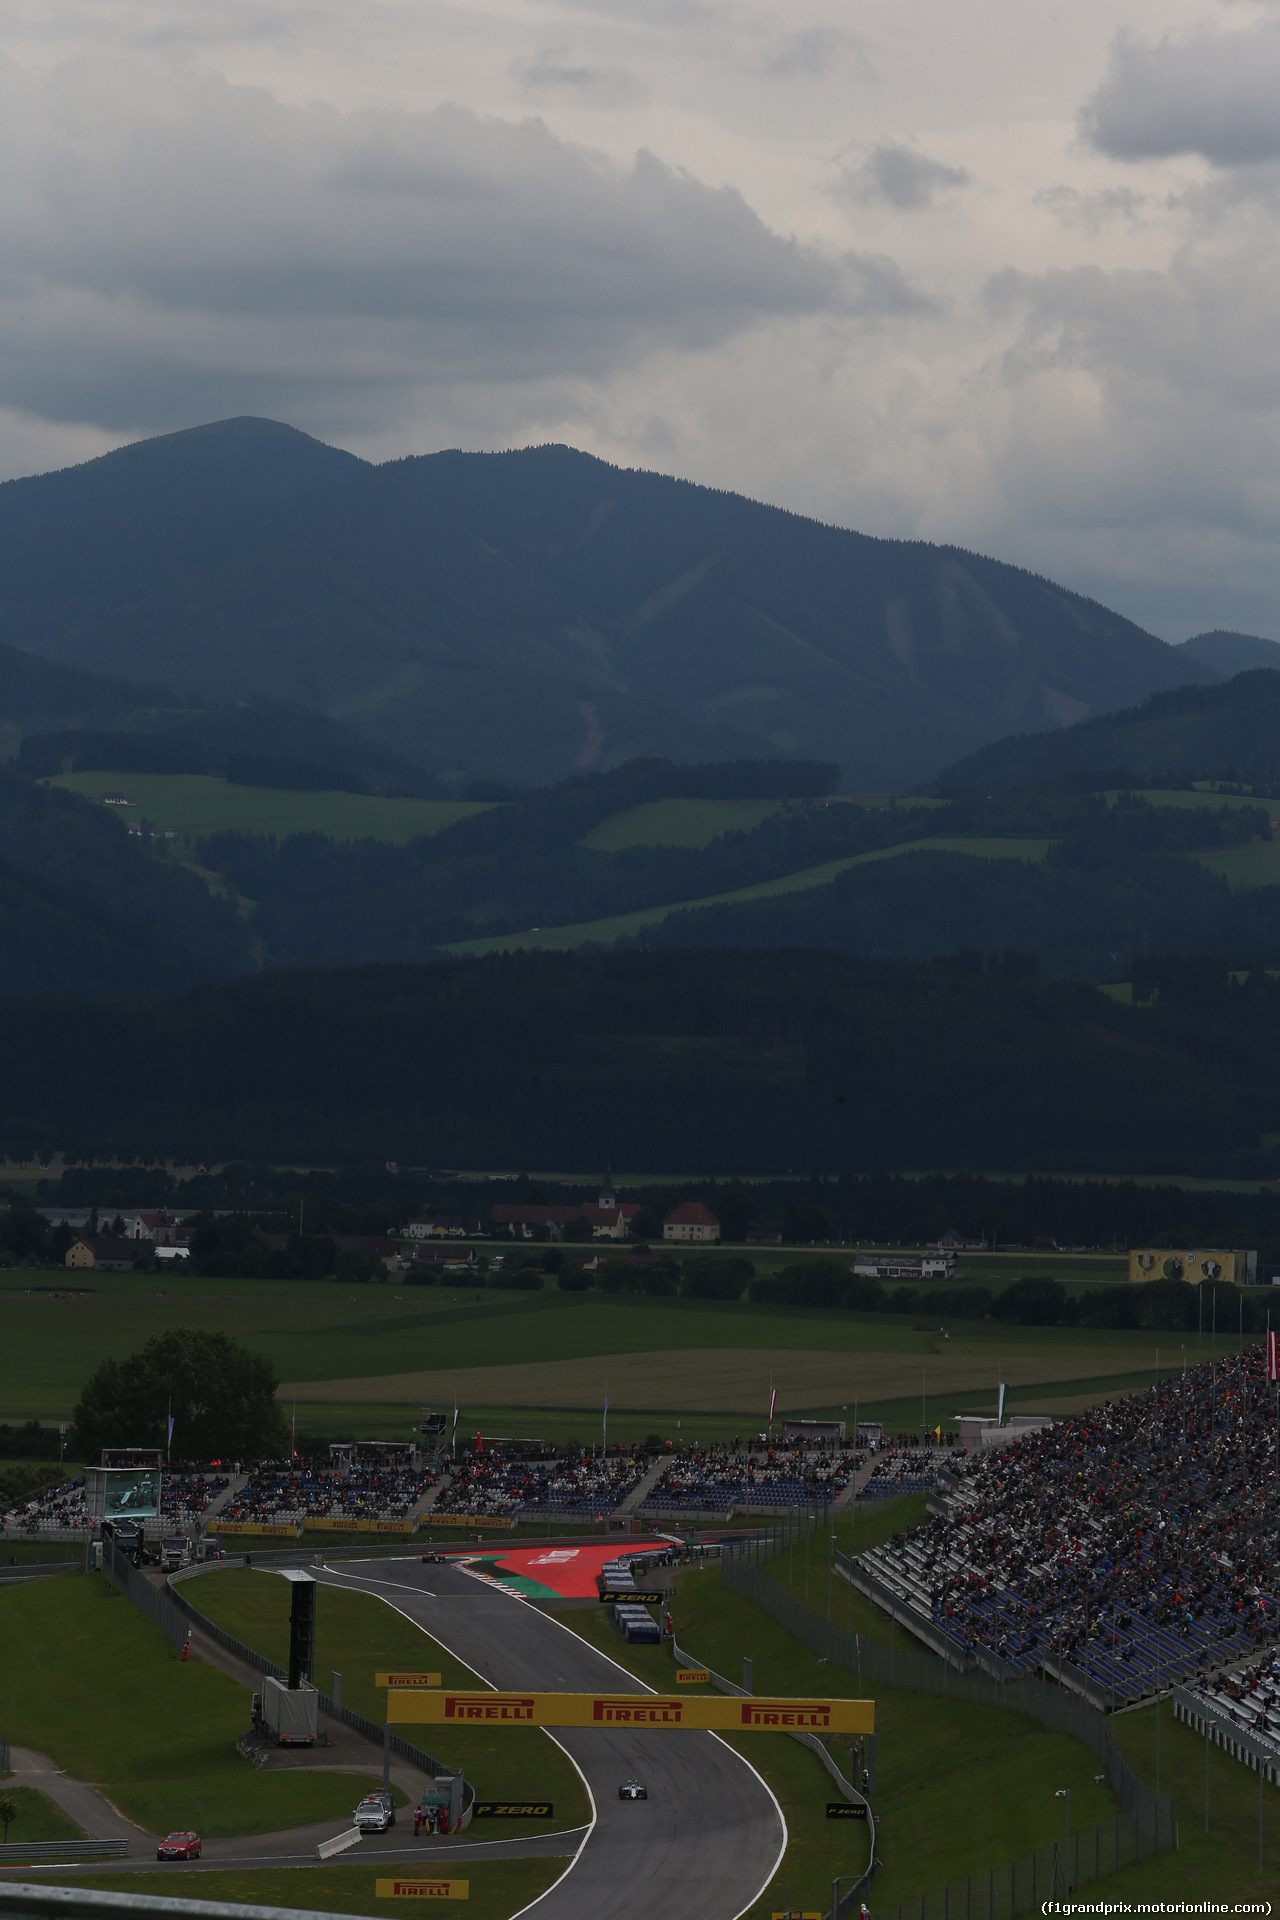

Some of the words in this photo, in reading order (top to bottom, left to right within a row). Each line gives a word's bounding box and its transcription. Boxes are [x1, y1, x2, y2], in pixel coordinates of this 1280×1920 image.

[388, 1675, 428, 1684] PIRELLI
[444, 1697, 535, 1720] PIRELLI
[593, 1700, 683, 1722] PIRELLI
[741, 1703, 831, 1726] PIRELLI
[477, 1806, 492, 1814] P
[494, 1806, 549, 1814] ZERO
[394, 1882, 450, 1896] PIRELLI
